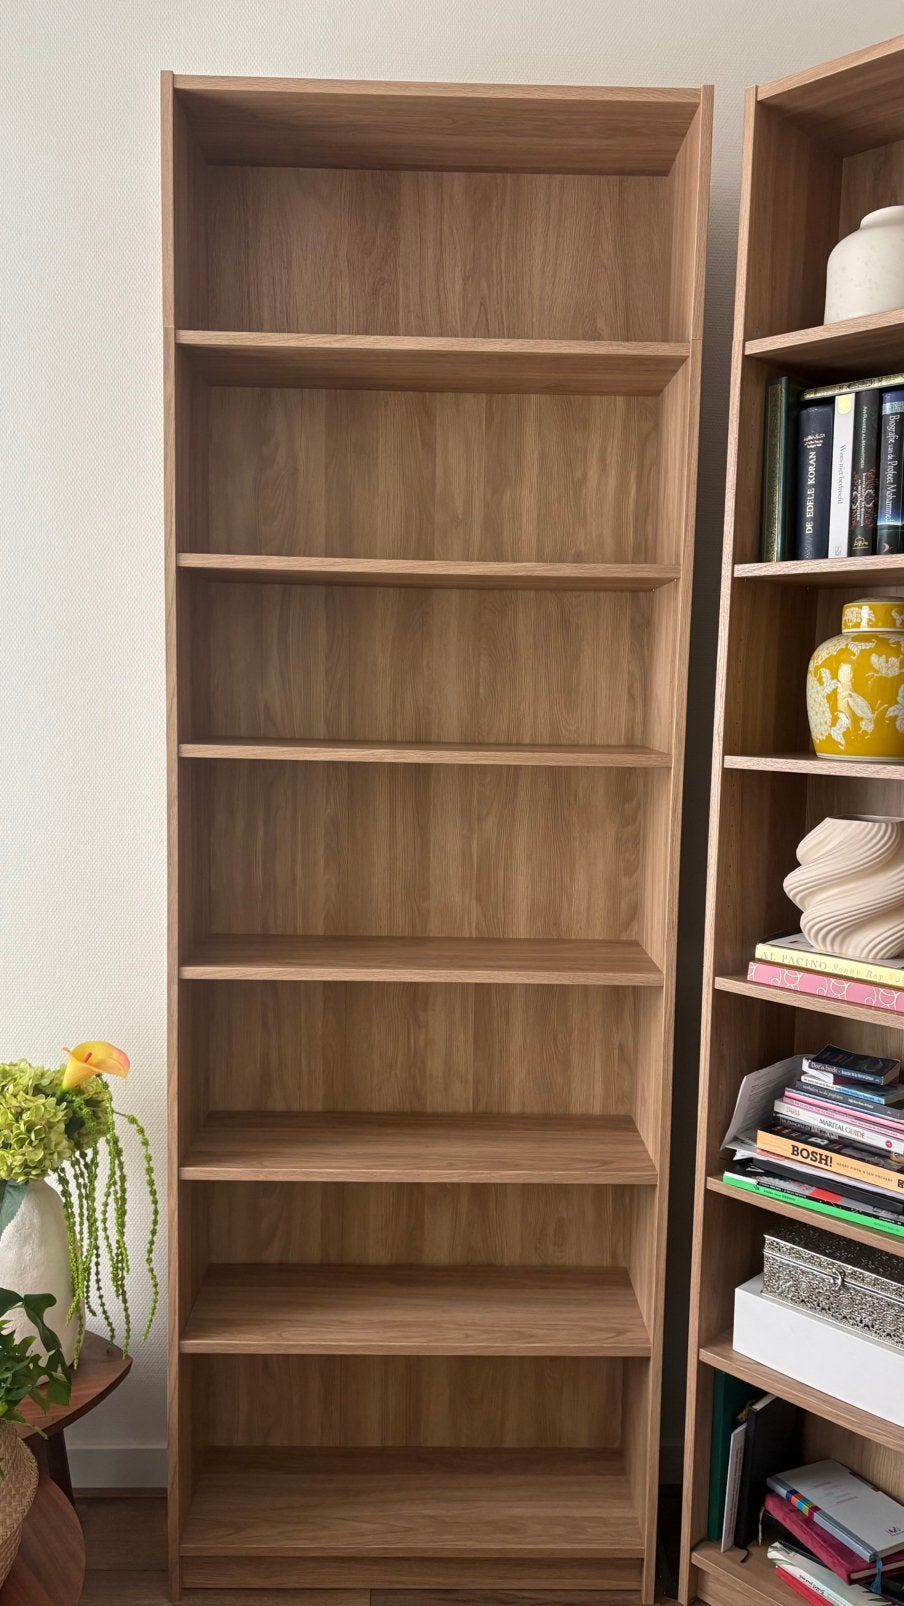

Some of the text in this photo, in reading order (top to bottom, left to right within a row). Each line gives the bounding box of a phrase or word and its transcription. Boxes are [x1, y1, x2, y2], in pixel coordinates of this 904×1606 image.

[886, 415, 900, 443] Biografie
[807, 450, 816, 486] KORAN
[886, 461, 897, 483] Profeet
[805, 487, 815, 518] EDELE
[836, 476, 845, 505] bedroefd
[805, 521, 814, 534] DE
[761, 951, 776, 962] AL
[781, 954, 828, 970] PACINO
[831, 964, 861, 979] Sonny
[865, 969, 884, 982] Boy
[819, 1118, 846, 1135] MARITAL
[845, 1125, 866, 1140] GUIDE
[790, 1144, 833, 1168] BOSH!
